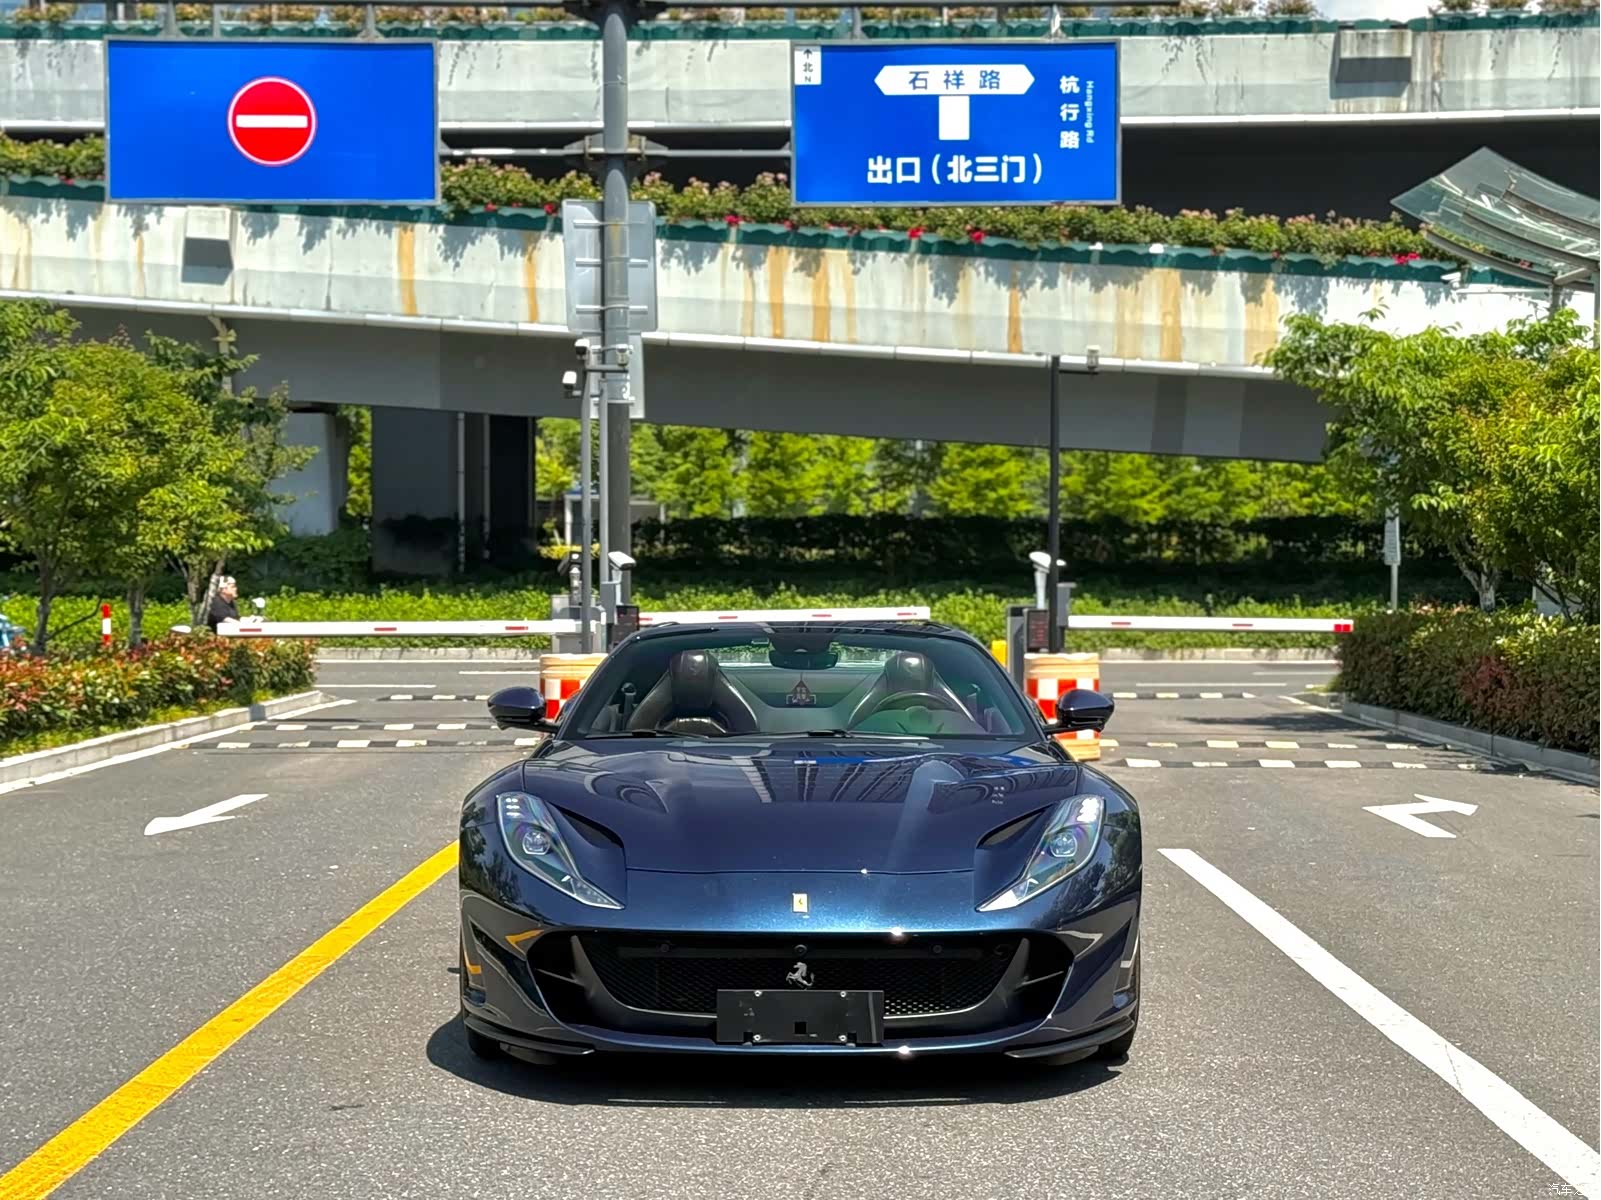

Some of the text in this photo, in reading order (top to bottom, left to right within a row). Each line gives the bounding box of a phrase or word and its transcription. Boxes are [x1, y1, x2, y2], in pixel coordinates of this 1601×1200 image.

[802, 62, 813, 73] 北
[908, 70, 1000, 90] 石祥路
[1060, 75, 1080, 149] 杭行路
[1084, 80, 1095, 144] Hangxing Rd
[867, 154, 1042, 184] 出口（北三门）
